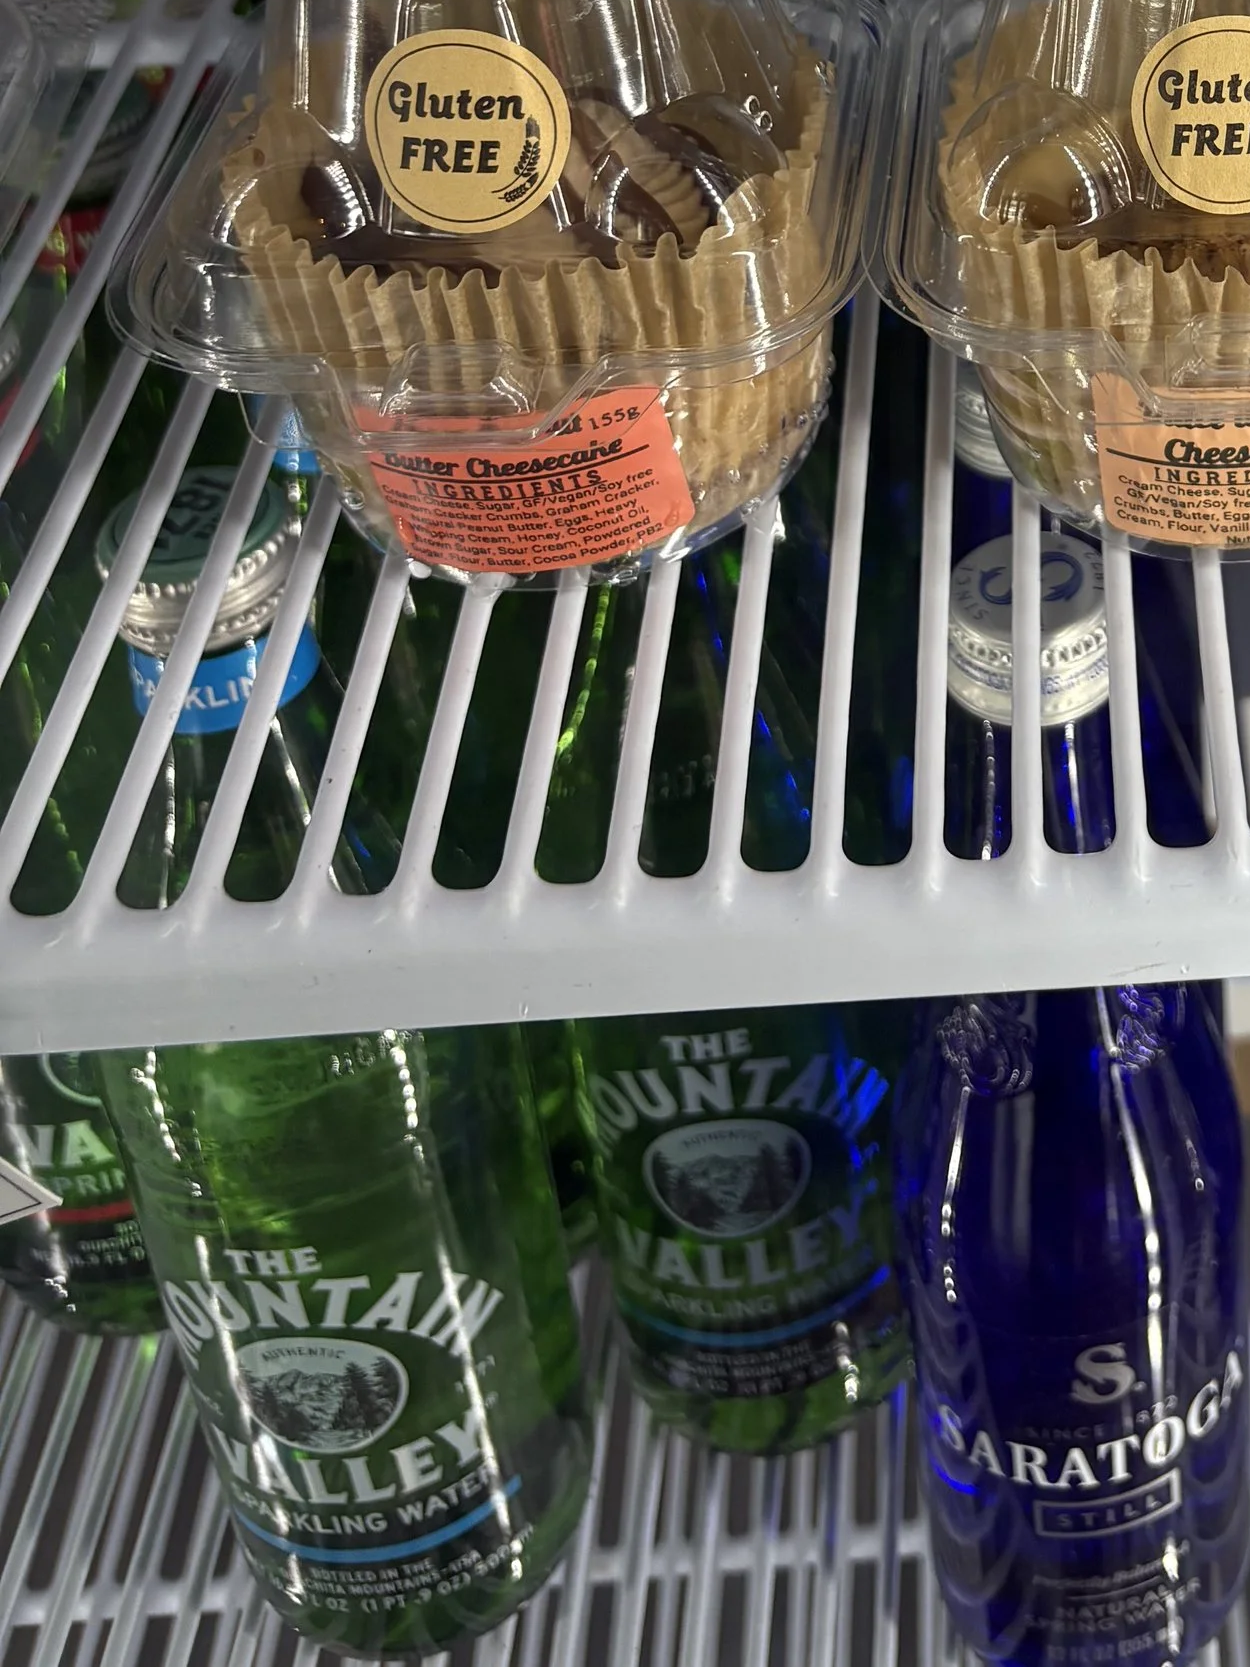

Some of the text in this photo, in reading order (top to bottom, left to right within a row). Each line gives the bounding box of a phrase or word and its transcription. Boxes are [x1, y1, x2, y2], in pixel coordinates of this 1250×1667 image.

[388, 80, 525, 122] Gluten
[400, 136, 500, 174] FREE
[588, 406, 641, 430] 155g
[384, 438, 623, 478] Butter Cheesecake
[412, 470, 604, 500] INGREDIENTS
[627, 468, 653, 483] free
[1118, 475, 1163, 491] Cream
[434, 508, 482, 521] Cracker
[546, 500, 600, 516] Graham
[1127, 488, 1228, 509] GF/Vegan/Soy
[457, 520, 504, 532] Peanut
[596, 498, 637, 517] Heavy
[567, 515, 624, 535] Coconut
[498, 545, 528, 555] Sour
[584, 517, 650, 545] Powdered
[533, 553, 577, 565] Cocoa
[637, 522, 664, 540] PB2
[661, 1027, 753, 1064] THE
[223, 1246, 323, 1277] THE
[262, 1345, 346, 1362] AUTHENTIC
[211, 1408, 487, 1505] VALLEY
[1057, 1494, 1162, 1528] STILL
